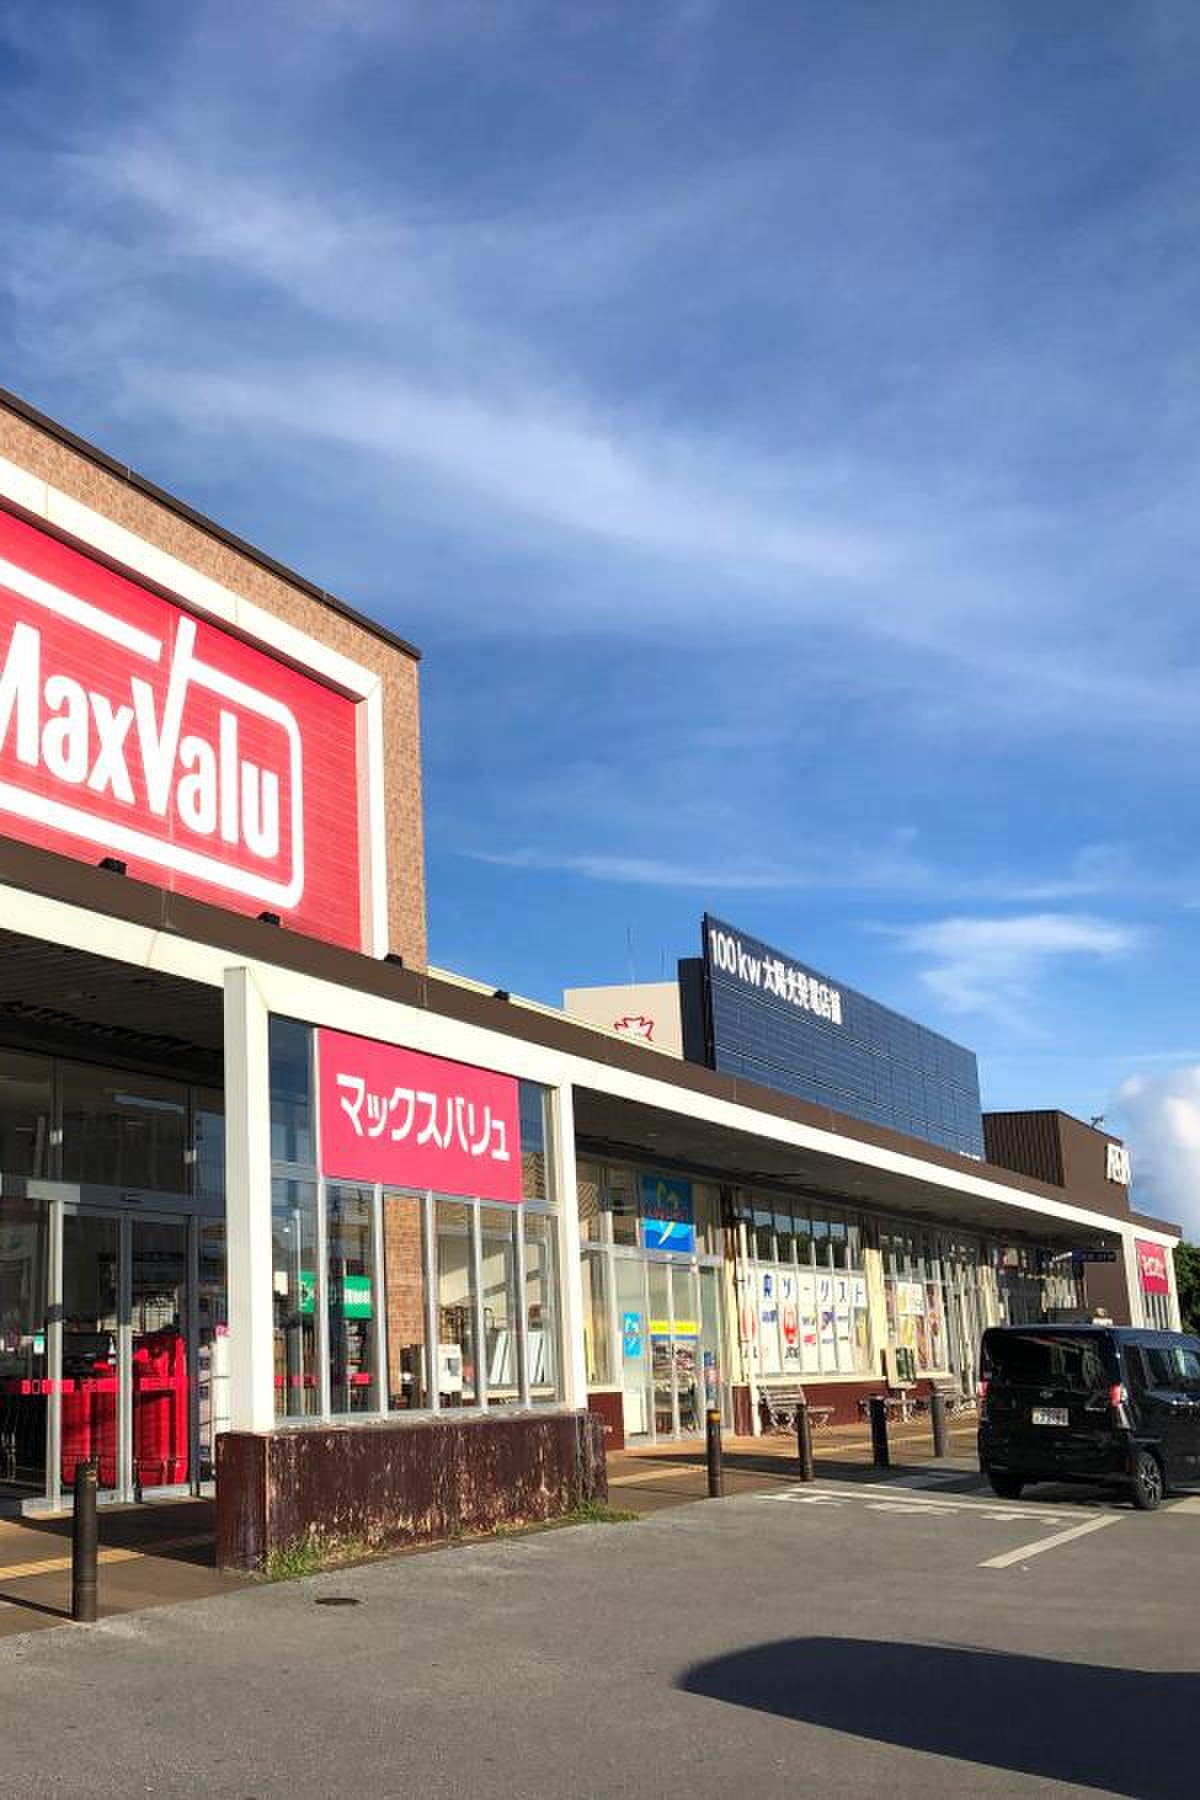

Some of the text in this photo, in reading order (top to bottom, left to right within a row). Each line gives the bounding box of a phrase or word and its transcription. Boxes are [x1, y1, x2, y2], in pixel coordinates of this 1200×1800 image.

[336, 1073, 511, 1161] マックスバリュ
